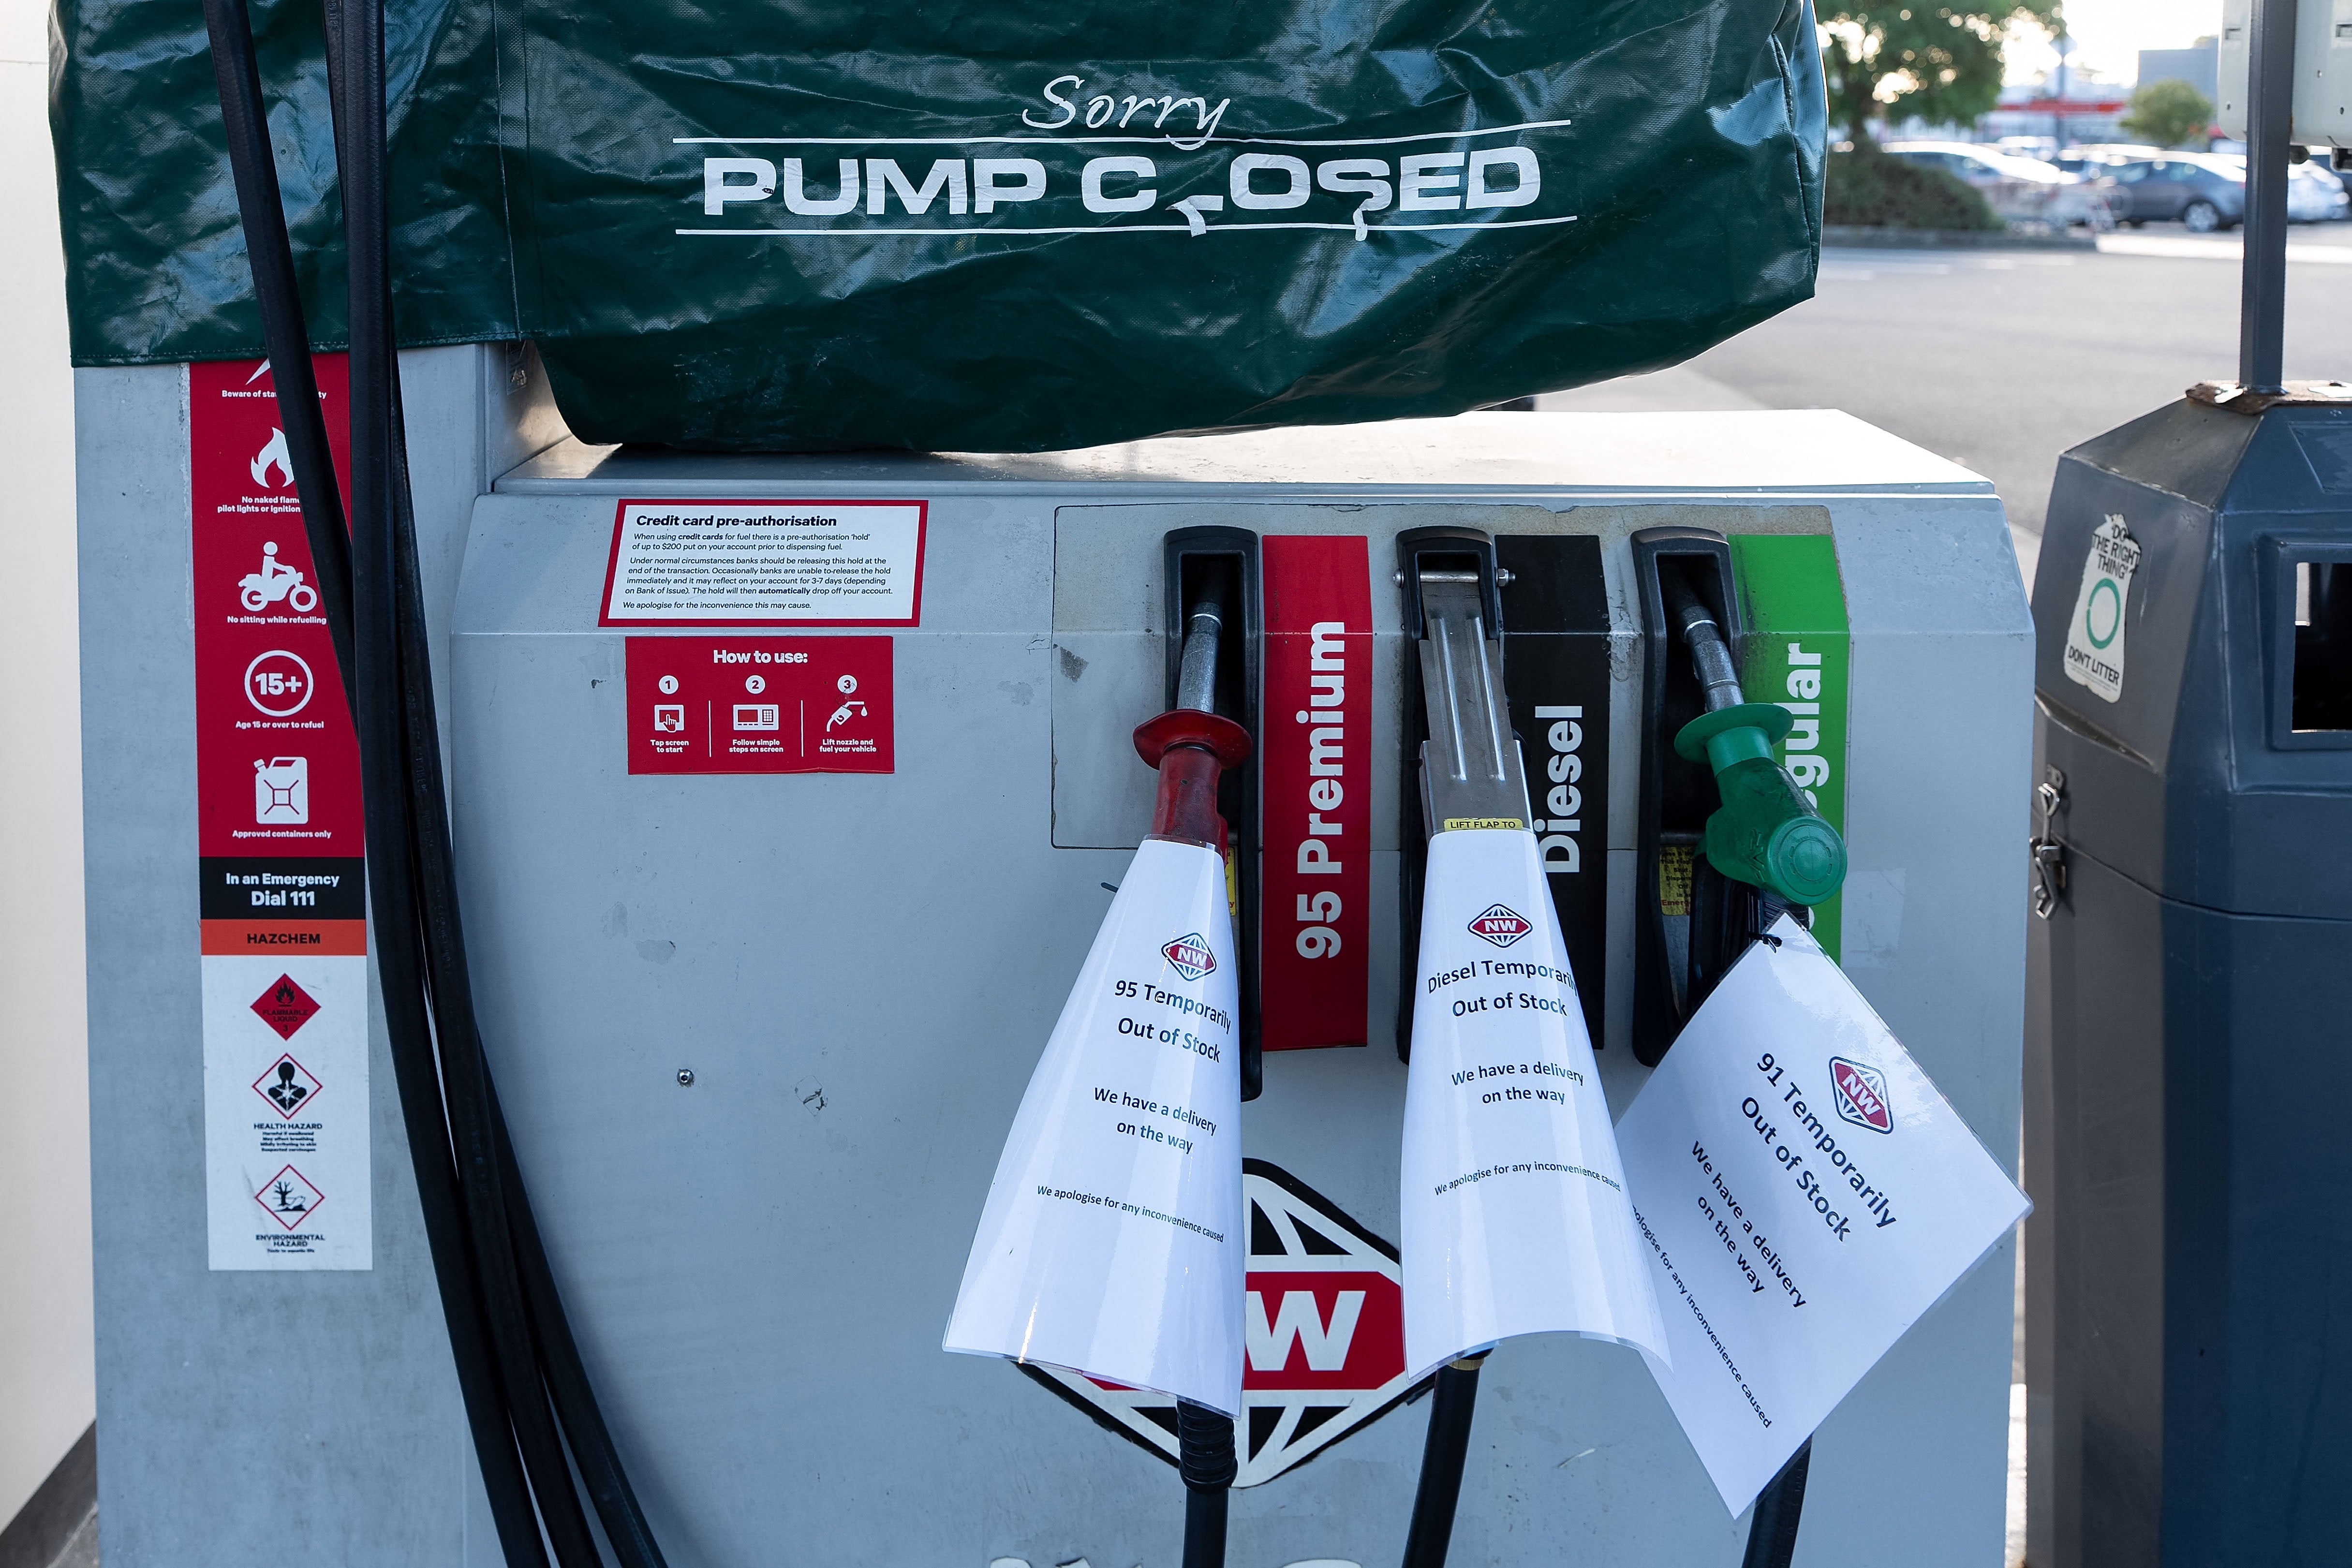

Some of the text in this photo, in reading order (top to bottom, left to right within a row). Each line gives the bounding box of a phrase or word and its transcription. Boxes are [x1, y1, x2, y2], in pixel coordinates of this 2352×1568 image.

[1022, 75, 1230, 150] Sorry
[704, 158, 1047, 216] PUMP
[218, 504, 236, 513] pilot
[237, 504, 259, 514] lights
[270, 505, 301, 514] ignition
[637, 515, 837, 528] Credit card pre-authorisation
[786, 543, 826, 551] dispensing
[2092, 533, 2141, 566] THE RIGHT
[239, 616, 266, 625] sitting
[289, 616, 327, 625] refuelling
[713, 650, 808, 664] How to use:
[255, 673, 302, 695] 15+
[2091, 658, 2120, 685] LITTER
[665, 680, 672, 689] 1
[752, 680, 759, 690] 2
[843, 680, 851, 690] 3
[236, 721, 251, 729] Age
[756, 739, 780, 747] simple
[1296, 622, 1345, 959] 95 Premium
[1533, 706, 1583, 873] Diesel
[232, 829, 271, 839] Approved
[314, 830, 332, 839] only
[226, 873, 340, 888] In an Emergency
[251, 890, 315, 906] Dial 111
[247, 933, 321, 944] HAZCHEM
[1484, 920, 1517, 932] NW
[1177, 947, 1207, 967] NW
[1428, 961, 1476, 994] Diesel
[1115, 980, 1231, 1035] 95 Temporarily
[1452, 992, 1568, 1017] Out of Stock
[283, 1024, 289, 1032] 3
[1118, 1018, 1221, 1064] Out of Stock
[1451, 1061, 1583, 1086] We have a delivery
[1482, 1086, 1565, 1105] on the way
[1841, 1072, 1882, 1116] NW
[1095, 1087, 1217, 1137] We have a delivery
[1117, 1122, 1193, 1155] on the way
[1757, 1052, 1897, 1229] 91 Temporarily
[1435, 1184, 1448, 1196] We
[1449, 1169, 1492, 1189] apologise
[1494, 1165, 1509, 1175] for
[1512, 1163, 1532, 1173] any
[1534, 1161, 1600, 1181] inconvenience
[1742, 1096, 1851, 1242] Out of Stock
[1037, 1185, 1225, 1243] We apologise for any inconvenience caused
[1692, 1140, 1807, 1308] We have a delivery
[1698, 1196, 1765, 1293] on the way
[1632, 1205, 1773, 1429] ologise for any inconvenience caused
[1245, 1291, 1366, 1371] W
